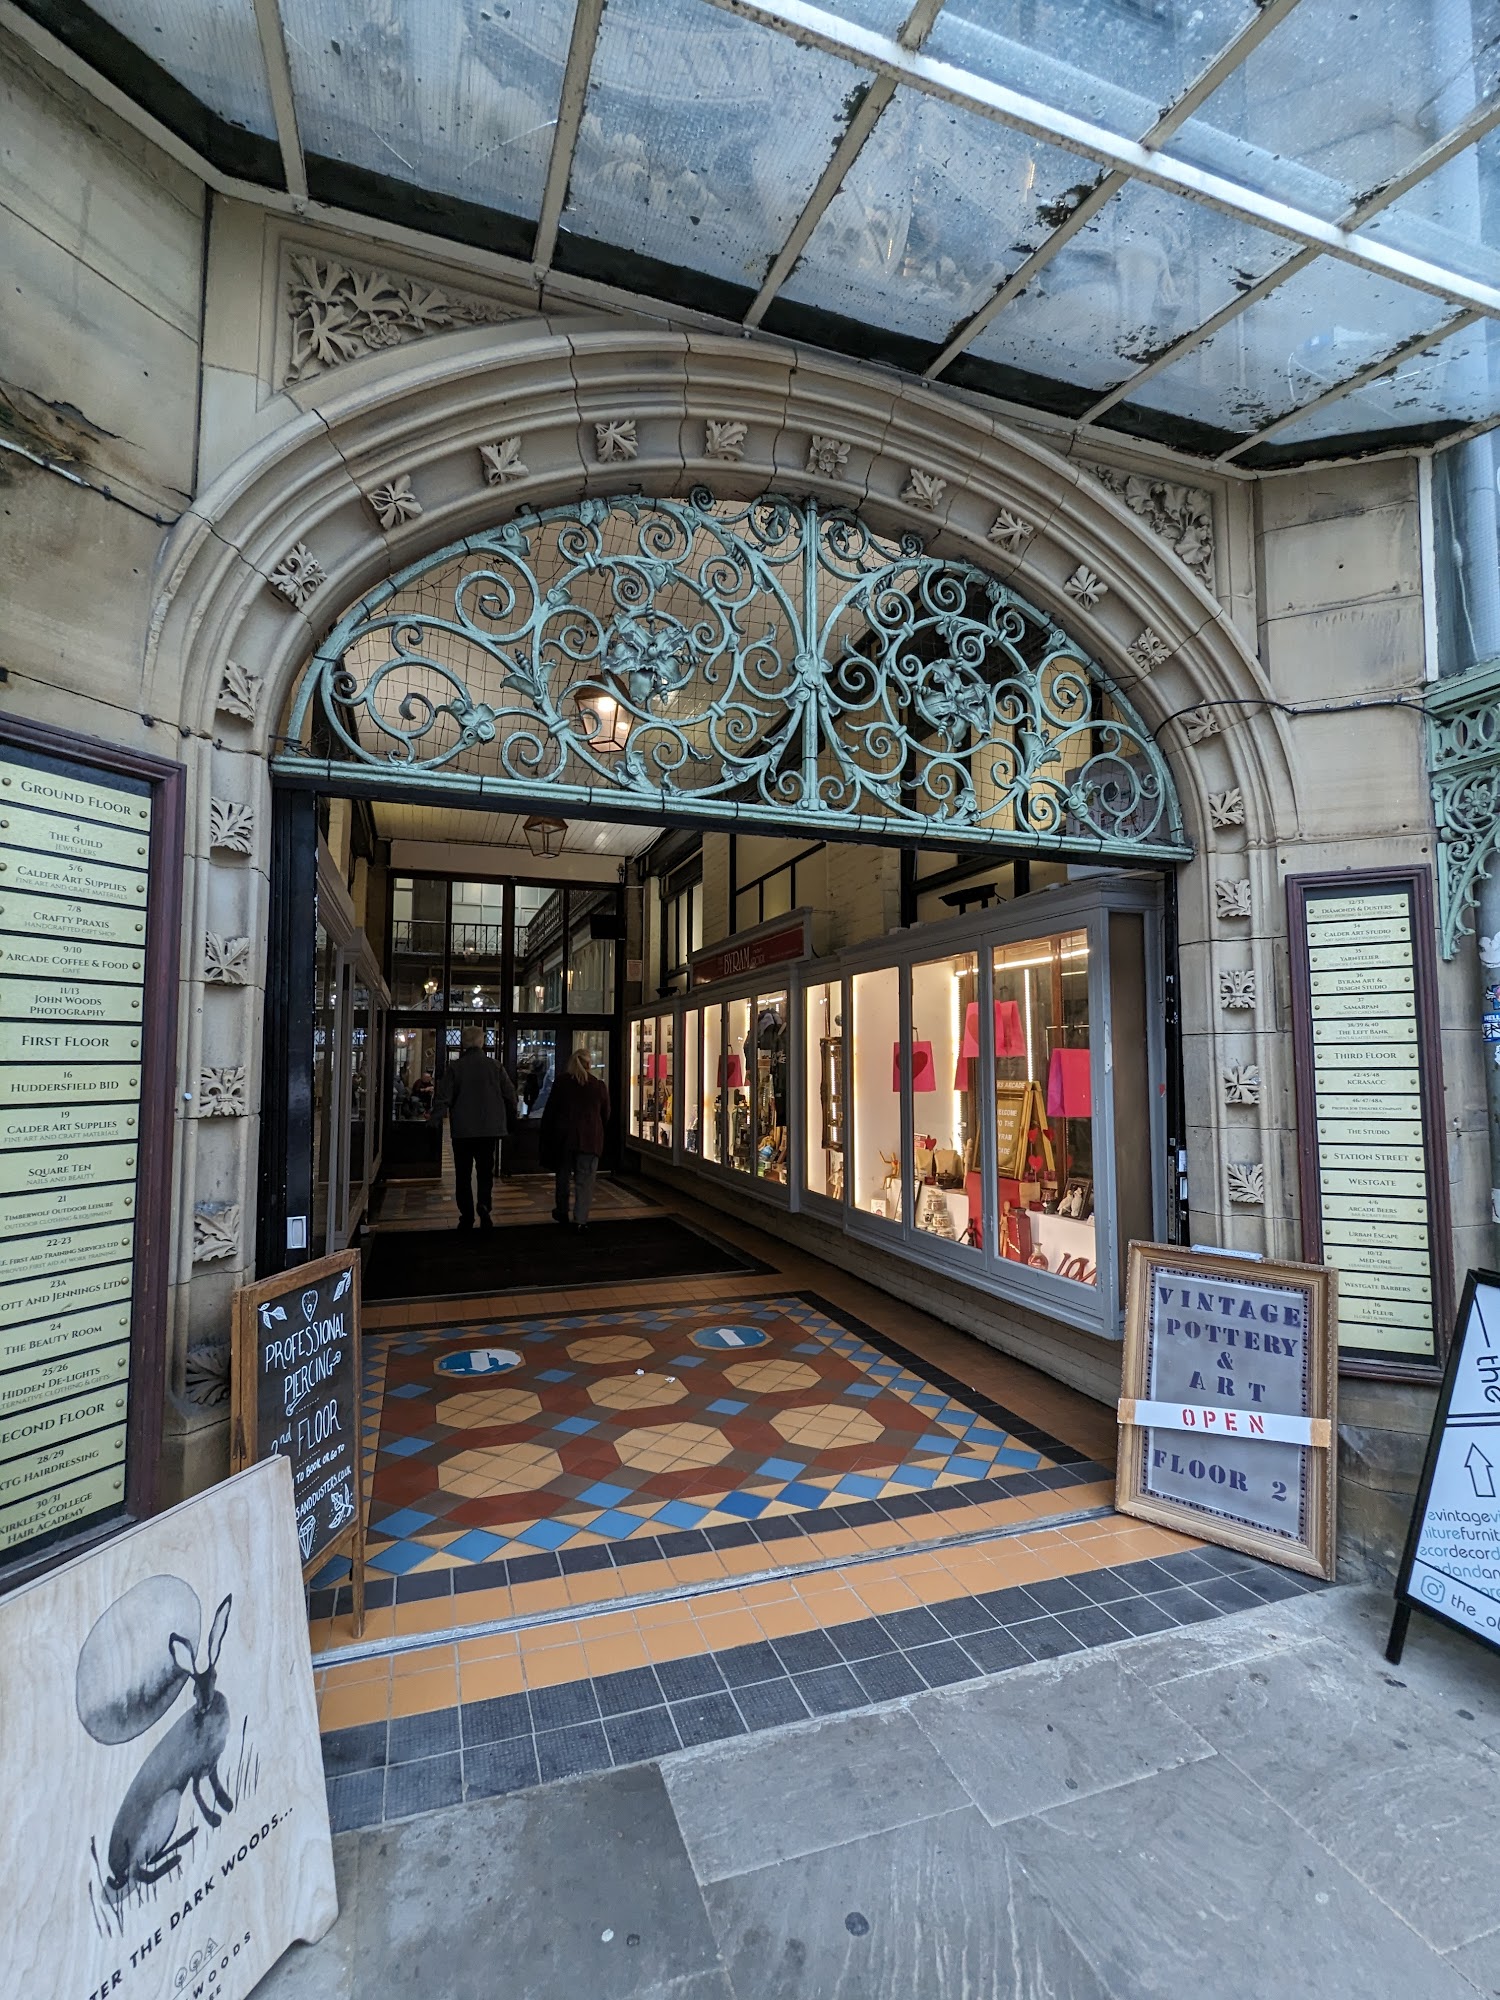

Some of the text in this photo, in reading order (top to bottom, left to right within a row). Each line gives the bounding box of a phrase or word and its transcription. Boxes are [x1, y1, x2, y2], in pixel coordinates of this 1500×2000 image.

[21, 781, 131, 815] GROUND FLOOR
[49, 831, 102, 849] THE GUILD
[55, 844, 96, 856] JEWELLERS
[69, 864, 83, 872] 5/6
[18, 866, 127, 892] CALDER ART SUPPLIES
[33, 911, 109, 928] CRAFTY PRAXIS
[63, 946, 82, 954] 9/10
[6, 954, 49, 963] ARCADE
[52, 957, 89, 966] COFFEE
[102, 961, 128, 970] FOOD
[724, 946, 750, 975] BYRAM
[34, 995, 102, 1005] JOHN WOODS
[60, 987, 80, 995] 11/13
[30, 1006, 106, 1016] PHOTOGRAPHY
[22, 1035, 109, 1047] FIRST FLOOR
[11, 1081, 119, 1092] HUDDERSFIELD BID
[7, 1121, 117, 1134] CALDER ART SUPPLIES
[28, 1164, 91, 1177] SQUARE TEN
[1348, 1178, 1397, 1186] WESTGATE
[58, 1195, 66, 1203] 21
[5, 1202, 113, 1221] TIMBERWOLF OUTDOOR LEISURE
[47, 1237, 72, 1247] 22-23
[25, 1296, 50, 1306] AND
[51, 1287, 101, 1302] JENNINGS
[103, 1281, 121, 1290] LTD
[1380, 1284, 1410, 1292] BARBERS
[1159, 1287, 1301, 1328] VINTAGE
[50, 1323, 61, 1331] 24
[5, 1326, 102, 1355] THE BEAUTY ROOM
[264, 1312, 347, 1373] PROFESSIONAL
[1167, 1318, 1299, 1357] POTTERY
[42, 1364, 69, 1376] 25/26
[1217, 1352, 1234, 1370] &
[2, 1368, 100, 1400] HIDDEN DE-LIGHTS
[284, 1349, 335, 1405] PIERCING
[1189, 1371, 1266, 1402] ART
[0, 1403, 105, 1444] ECOND FLOOR
[297, 1399, 341, 1457] FLOOR
[1182, 1408, 1265, 1434] OPEN
[37, 1450, 64, 1464] 28/29
[297, 1444, 345, 1484] TO BOOK OR GO TO
[24, 1451, 99, 1482] HAIRDRESSING
[1153, 1448, 1288, 1502] FLOOR 2
[36, 1494, 61, 1509] 30/31
[49, 1493, 92, 1515] COLLEGE
[7, 1507, 86, 1544] HAIR ACADEMY
[129, 1927, 162, 1969] THE
[170, 1876, 216, 1930] DARK
[221, 1807, 294, 1877] WOODS...
